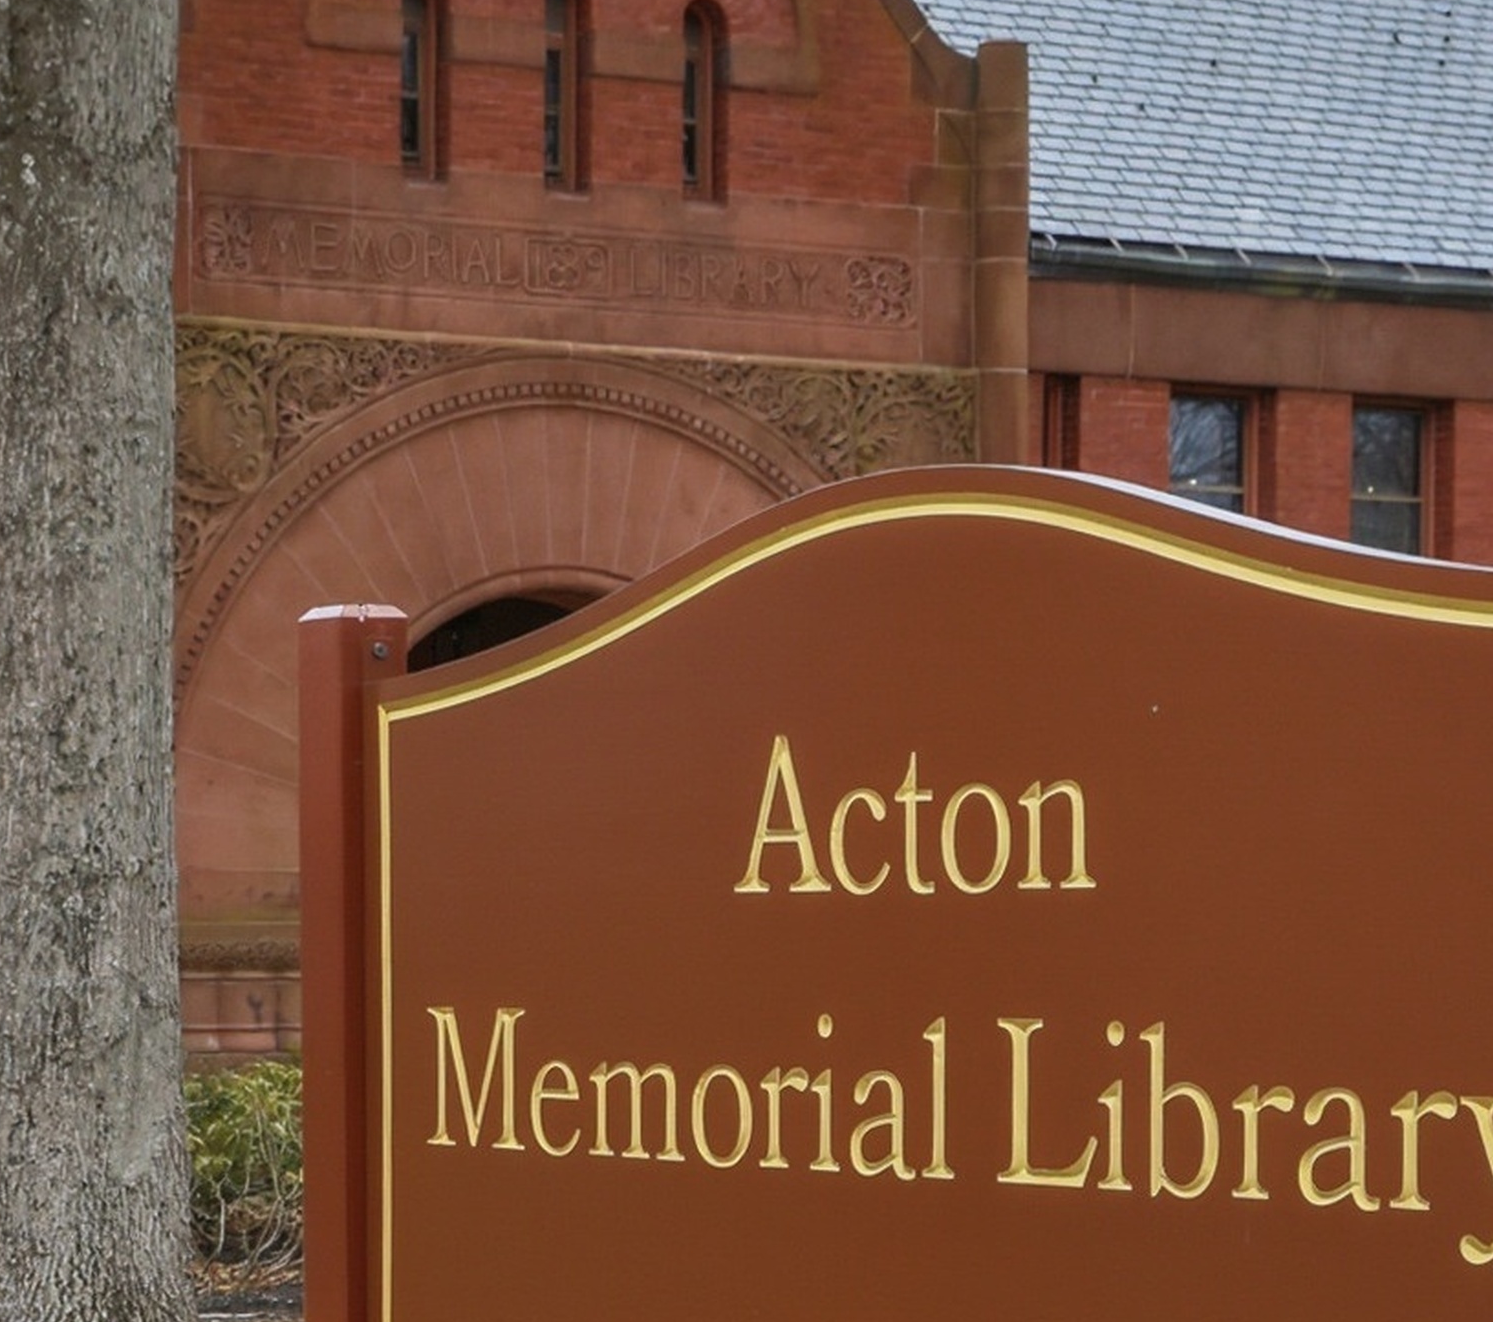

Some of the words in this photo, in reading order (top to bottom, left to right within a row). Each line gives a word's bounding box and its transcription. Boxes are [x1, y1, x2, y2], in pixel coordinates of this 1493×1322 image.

[261, 220, 520, 286] MEMORIAL
[628, 241, 820, 309] LIBRARY
[733, 734, 1097, 896] Acton
[426, 1005, 955, 1182] Memorial
